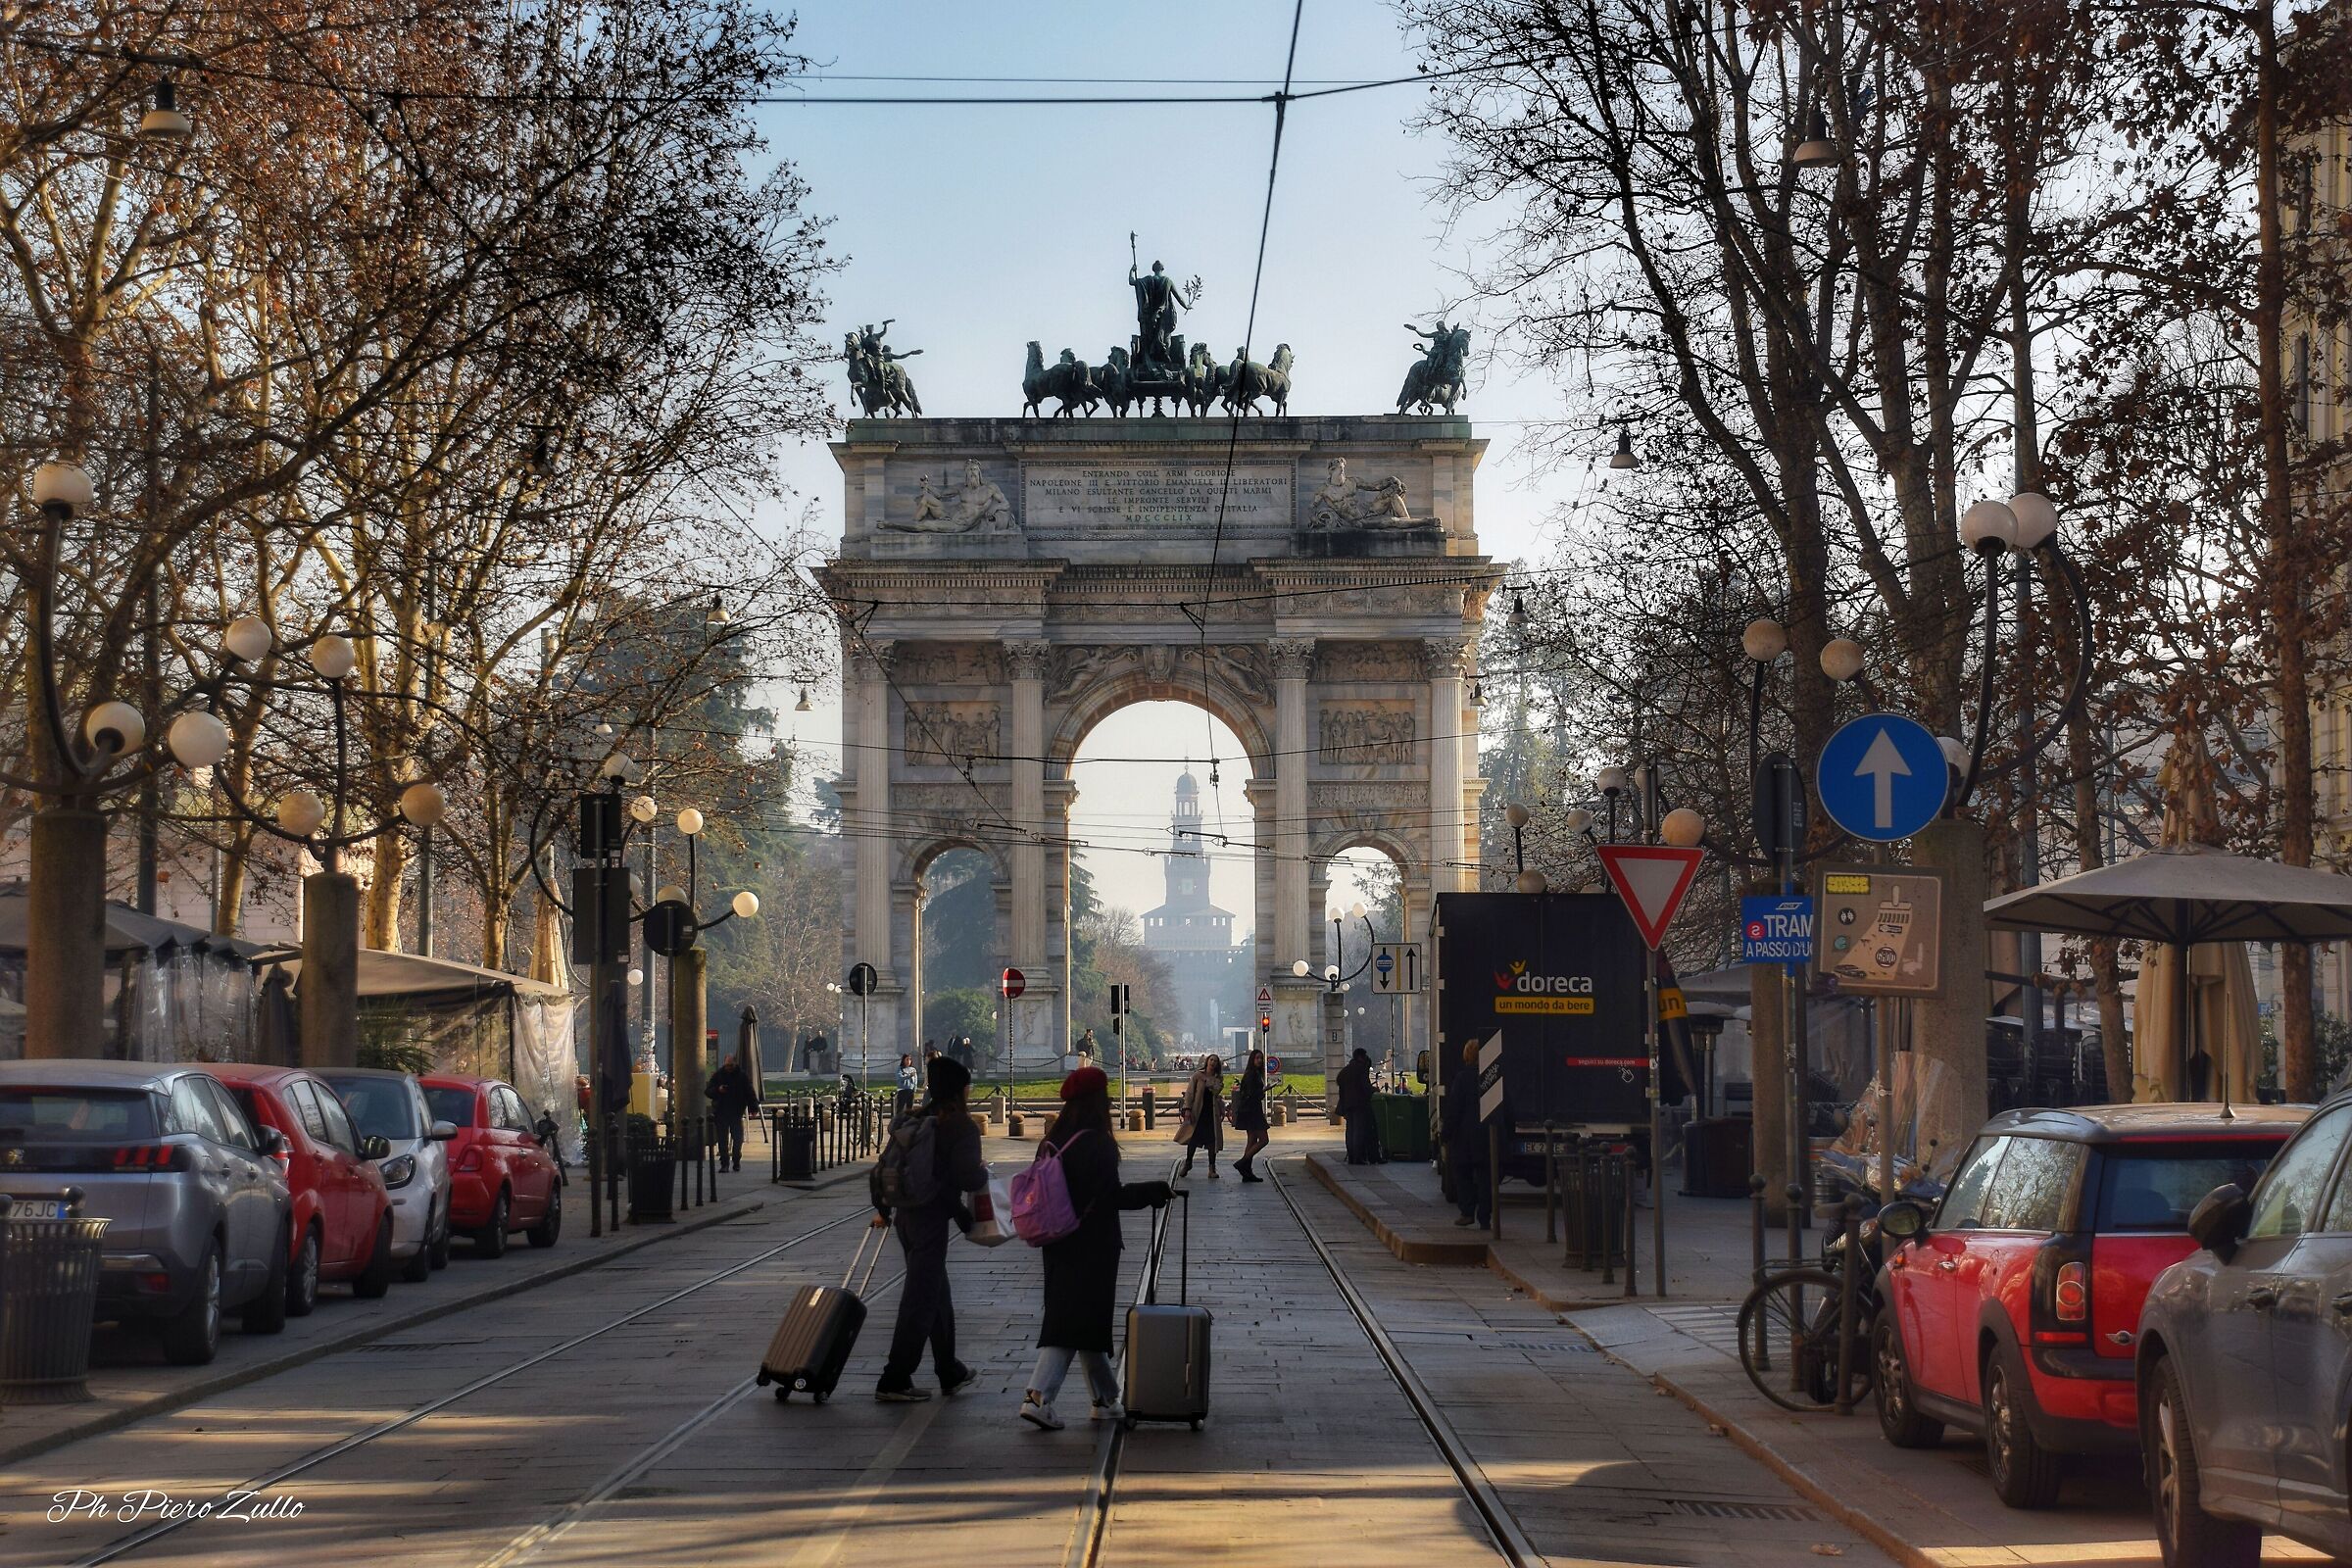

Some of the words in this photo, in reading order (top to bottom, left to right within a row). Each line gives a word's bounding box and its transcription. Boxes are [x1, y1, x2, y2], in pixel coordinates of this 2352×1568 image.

[1763, 914, 1814, 938] TRAM
[1745, 941, 1754, 957] A
[1755, 941, 1791, 957] PASSO
[1516, 970, 1592, 993] doreca
[1499, 1001, 1512, 1009] un
[1515, 1000, 1549, 1009] mondo
[1552, 1000, 1565, 1009] da
[1567, 1000, 1590, 1010] bere
[10, 1201, 56, 1217] 76JC
